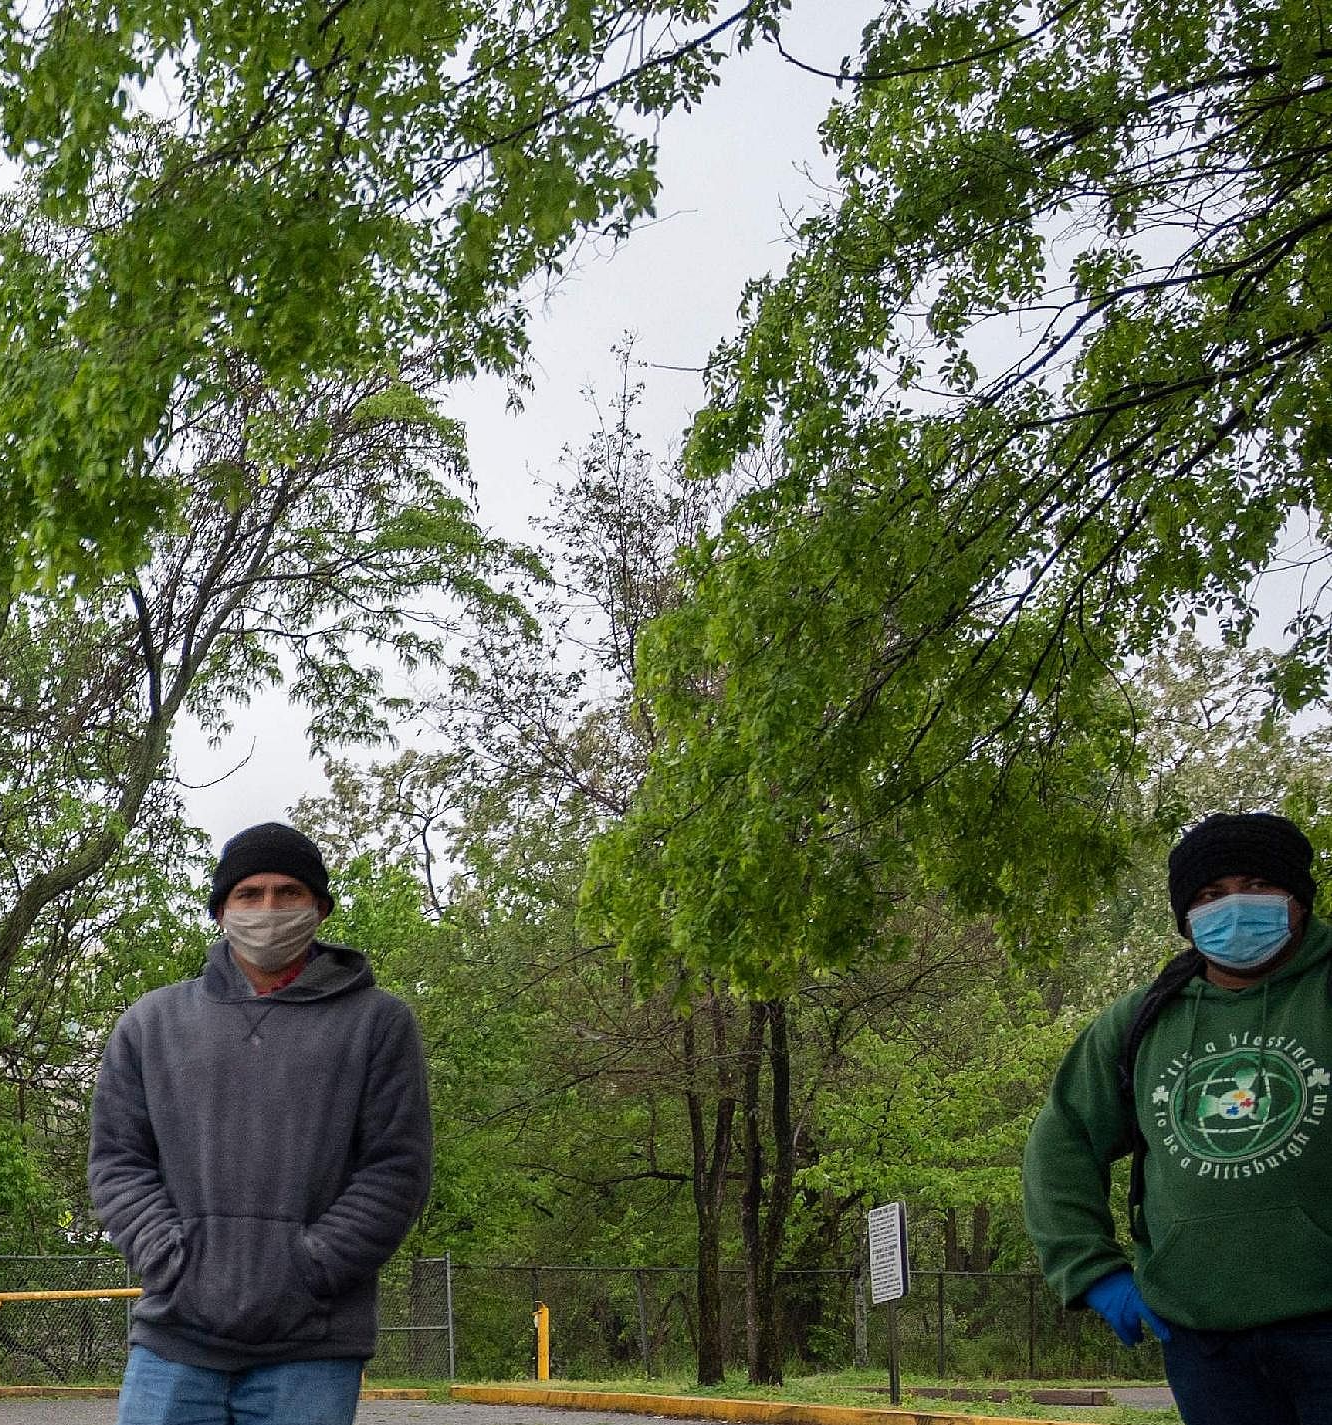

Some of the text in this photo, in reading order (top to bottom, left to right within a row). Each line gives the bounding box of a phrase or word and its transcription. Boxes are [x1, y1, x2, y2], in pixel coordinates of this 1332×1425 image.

[1204, 1041, 1216, 1053] a
[1228, 1031, 1316, 1071] blessing
[1155, 1094, 1328, 1180] to be a Pittsburgh fan
